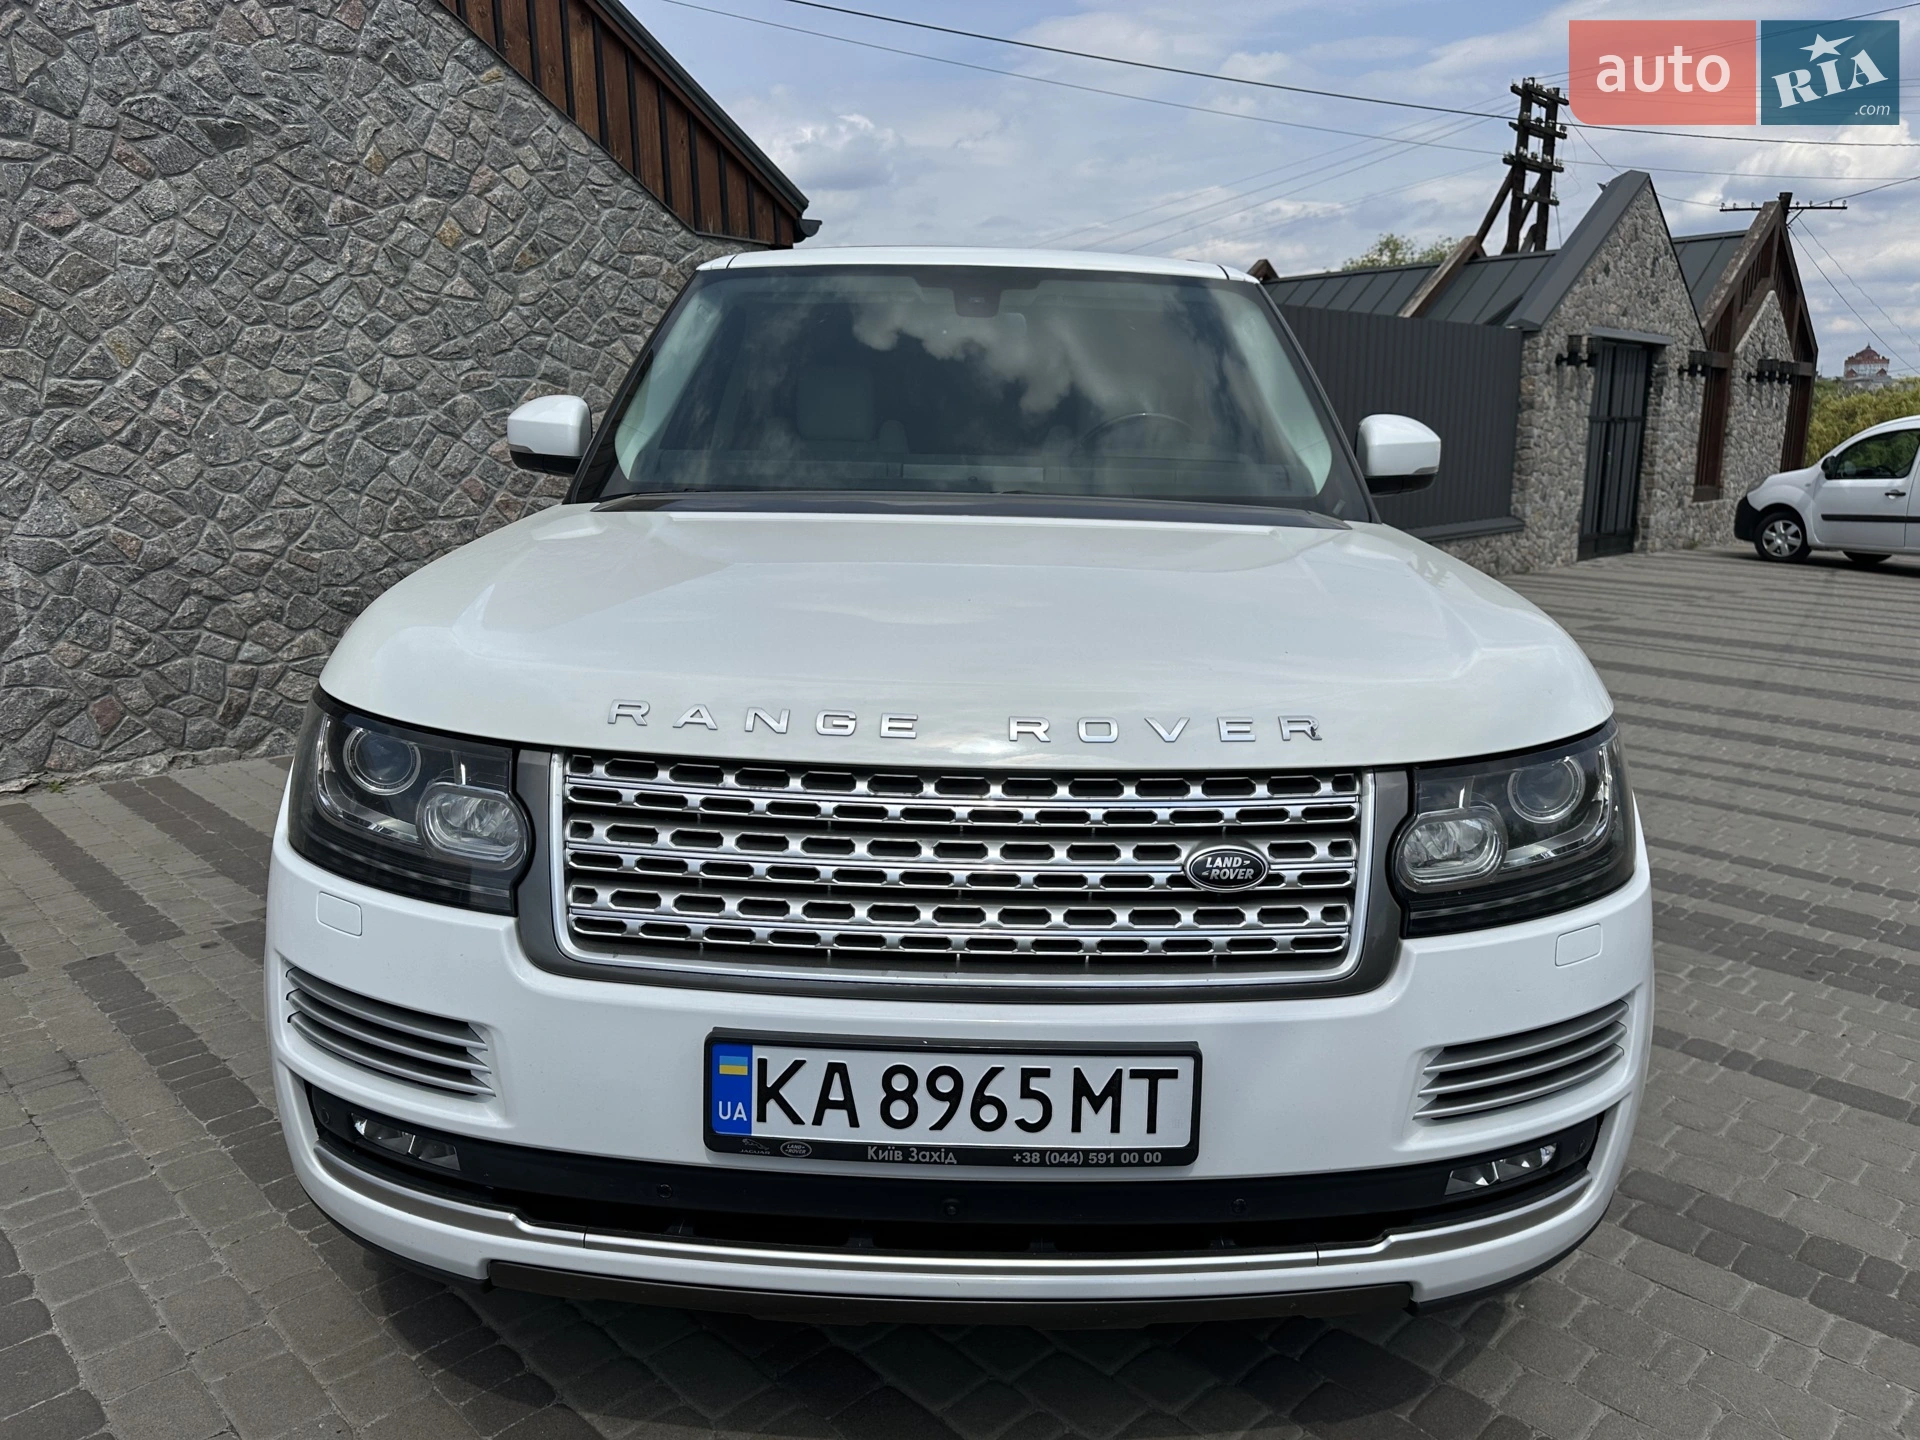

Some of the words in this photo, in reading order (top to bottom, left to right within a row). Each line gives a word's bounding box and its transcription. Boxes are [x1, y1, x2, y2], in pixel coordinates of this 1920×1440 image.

[607, 699, 918, 739] RANGE
[1008, 715, 1323, 743] ROVER
[1206, 857, 1242, 868] LAND
[1209, 868, 1254, 880] ROVER
[756, 1057, 860, 1128] KA
[880, 1063, 1053, 1133] 8965
[1071, 1067, 1179, 1134] MT
[718, 1101, 748, 1122] UA
[867, 1146, 903, 1161] Київ
[908, 1147, 957, 1164] Захід
[1013, 1152, 1040, 1163] +38
[1045, 1151, 1083, 1165] (044)
[1088, 1152, 1114, 1163] 591
[1120, 1152, 1139, 1163] 00
[1143, 1151, 1162, 1163] 00
